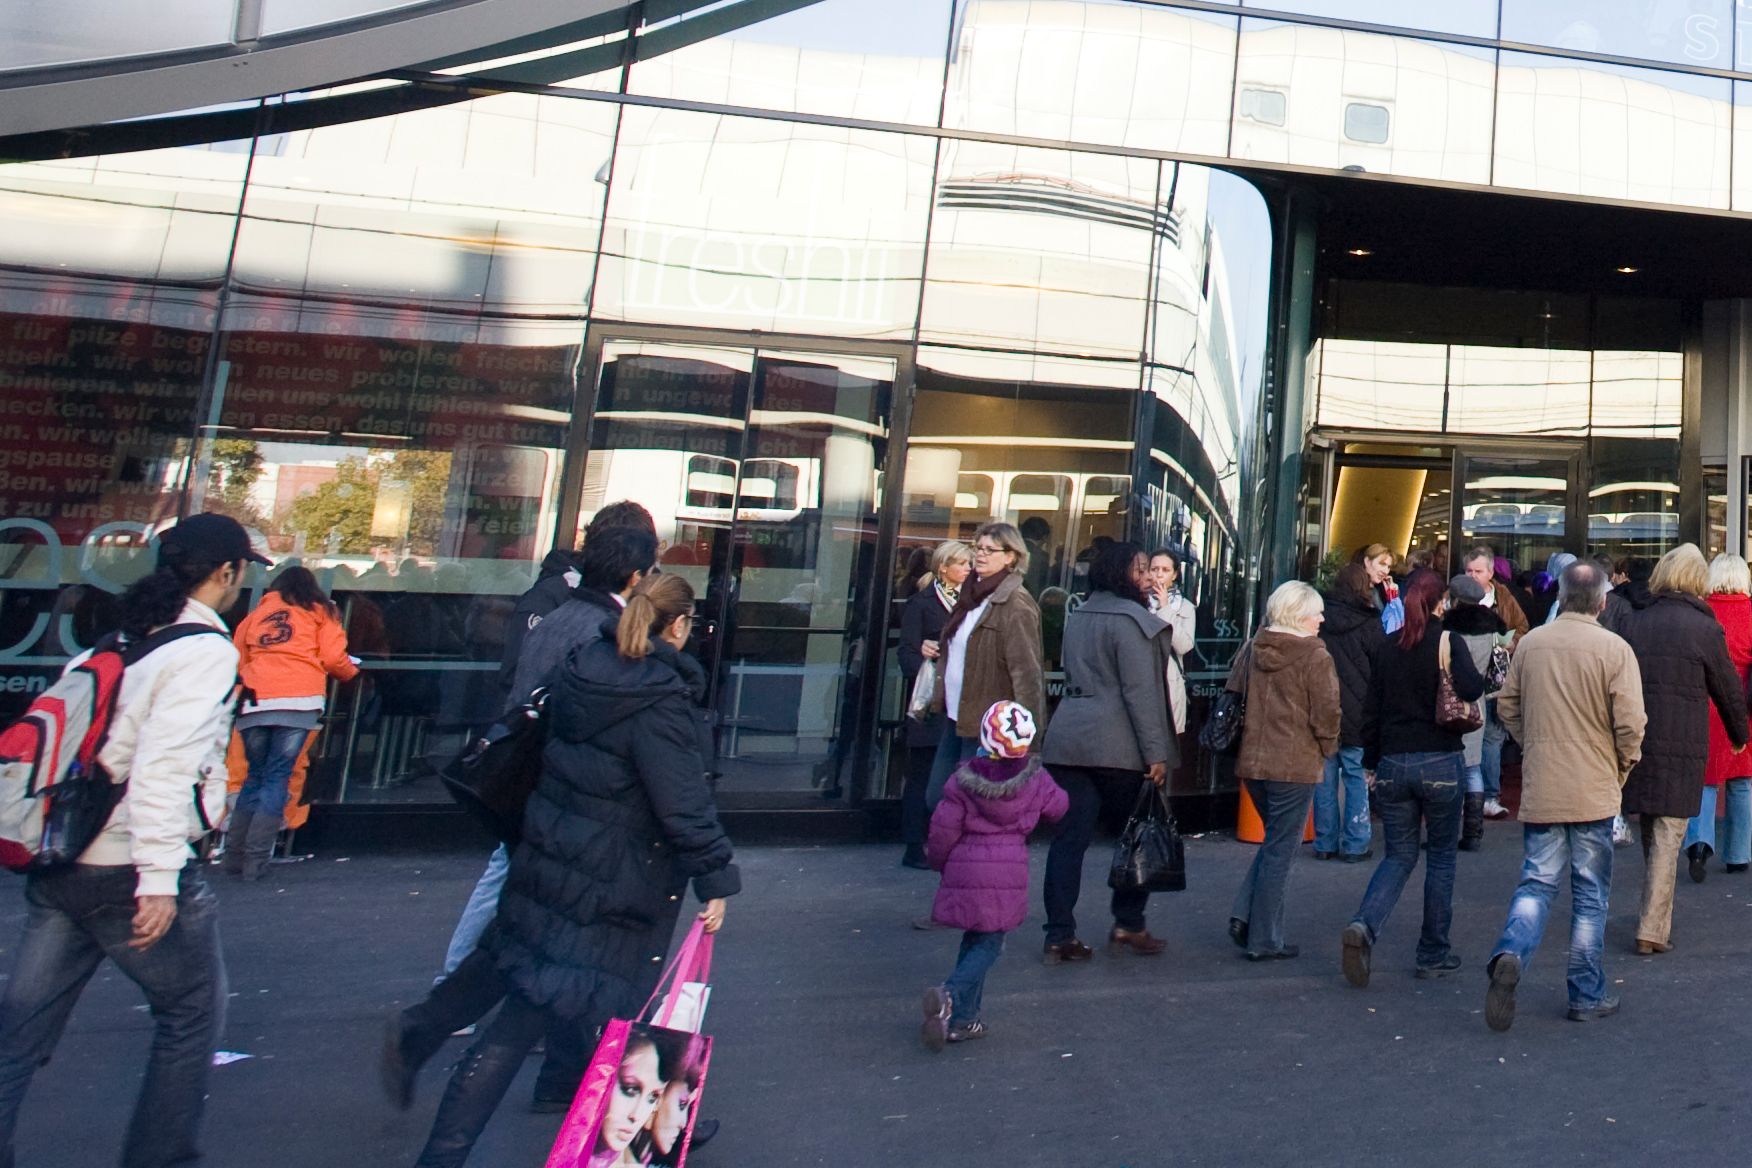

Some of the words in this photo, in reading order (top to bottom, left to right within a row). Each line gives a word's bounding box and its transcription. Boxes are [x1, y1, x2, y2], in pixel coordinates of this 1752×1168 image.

[12, 320, 57, 342] für
[66, 326, 138, 349] pilze
[151, 330, 307, 358] begstern.
[322, 342, 367, 361] wir
[93, 351, 140, 372] wir
[256, 363, 340, 384] neues
[133, 378, 178, 397] wir
[281, 389, 331, 407] uns
[336, 390, 401, 411] wohl
[37, 422, 86, 444] wir
[112, 400, 160, 422] wir
[355, 414, 405, 434] das
[409, 420, 458, 437] uns
[461, 422, 505, 442] gut
[64, 474, 113, 494] wir
[15, 500, 52, 518] zu
[61, 501, 115, 521] uns
[257, 608, 297, 649] 3
